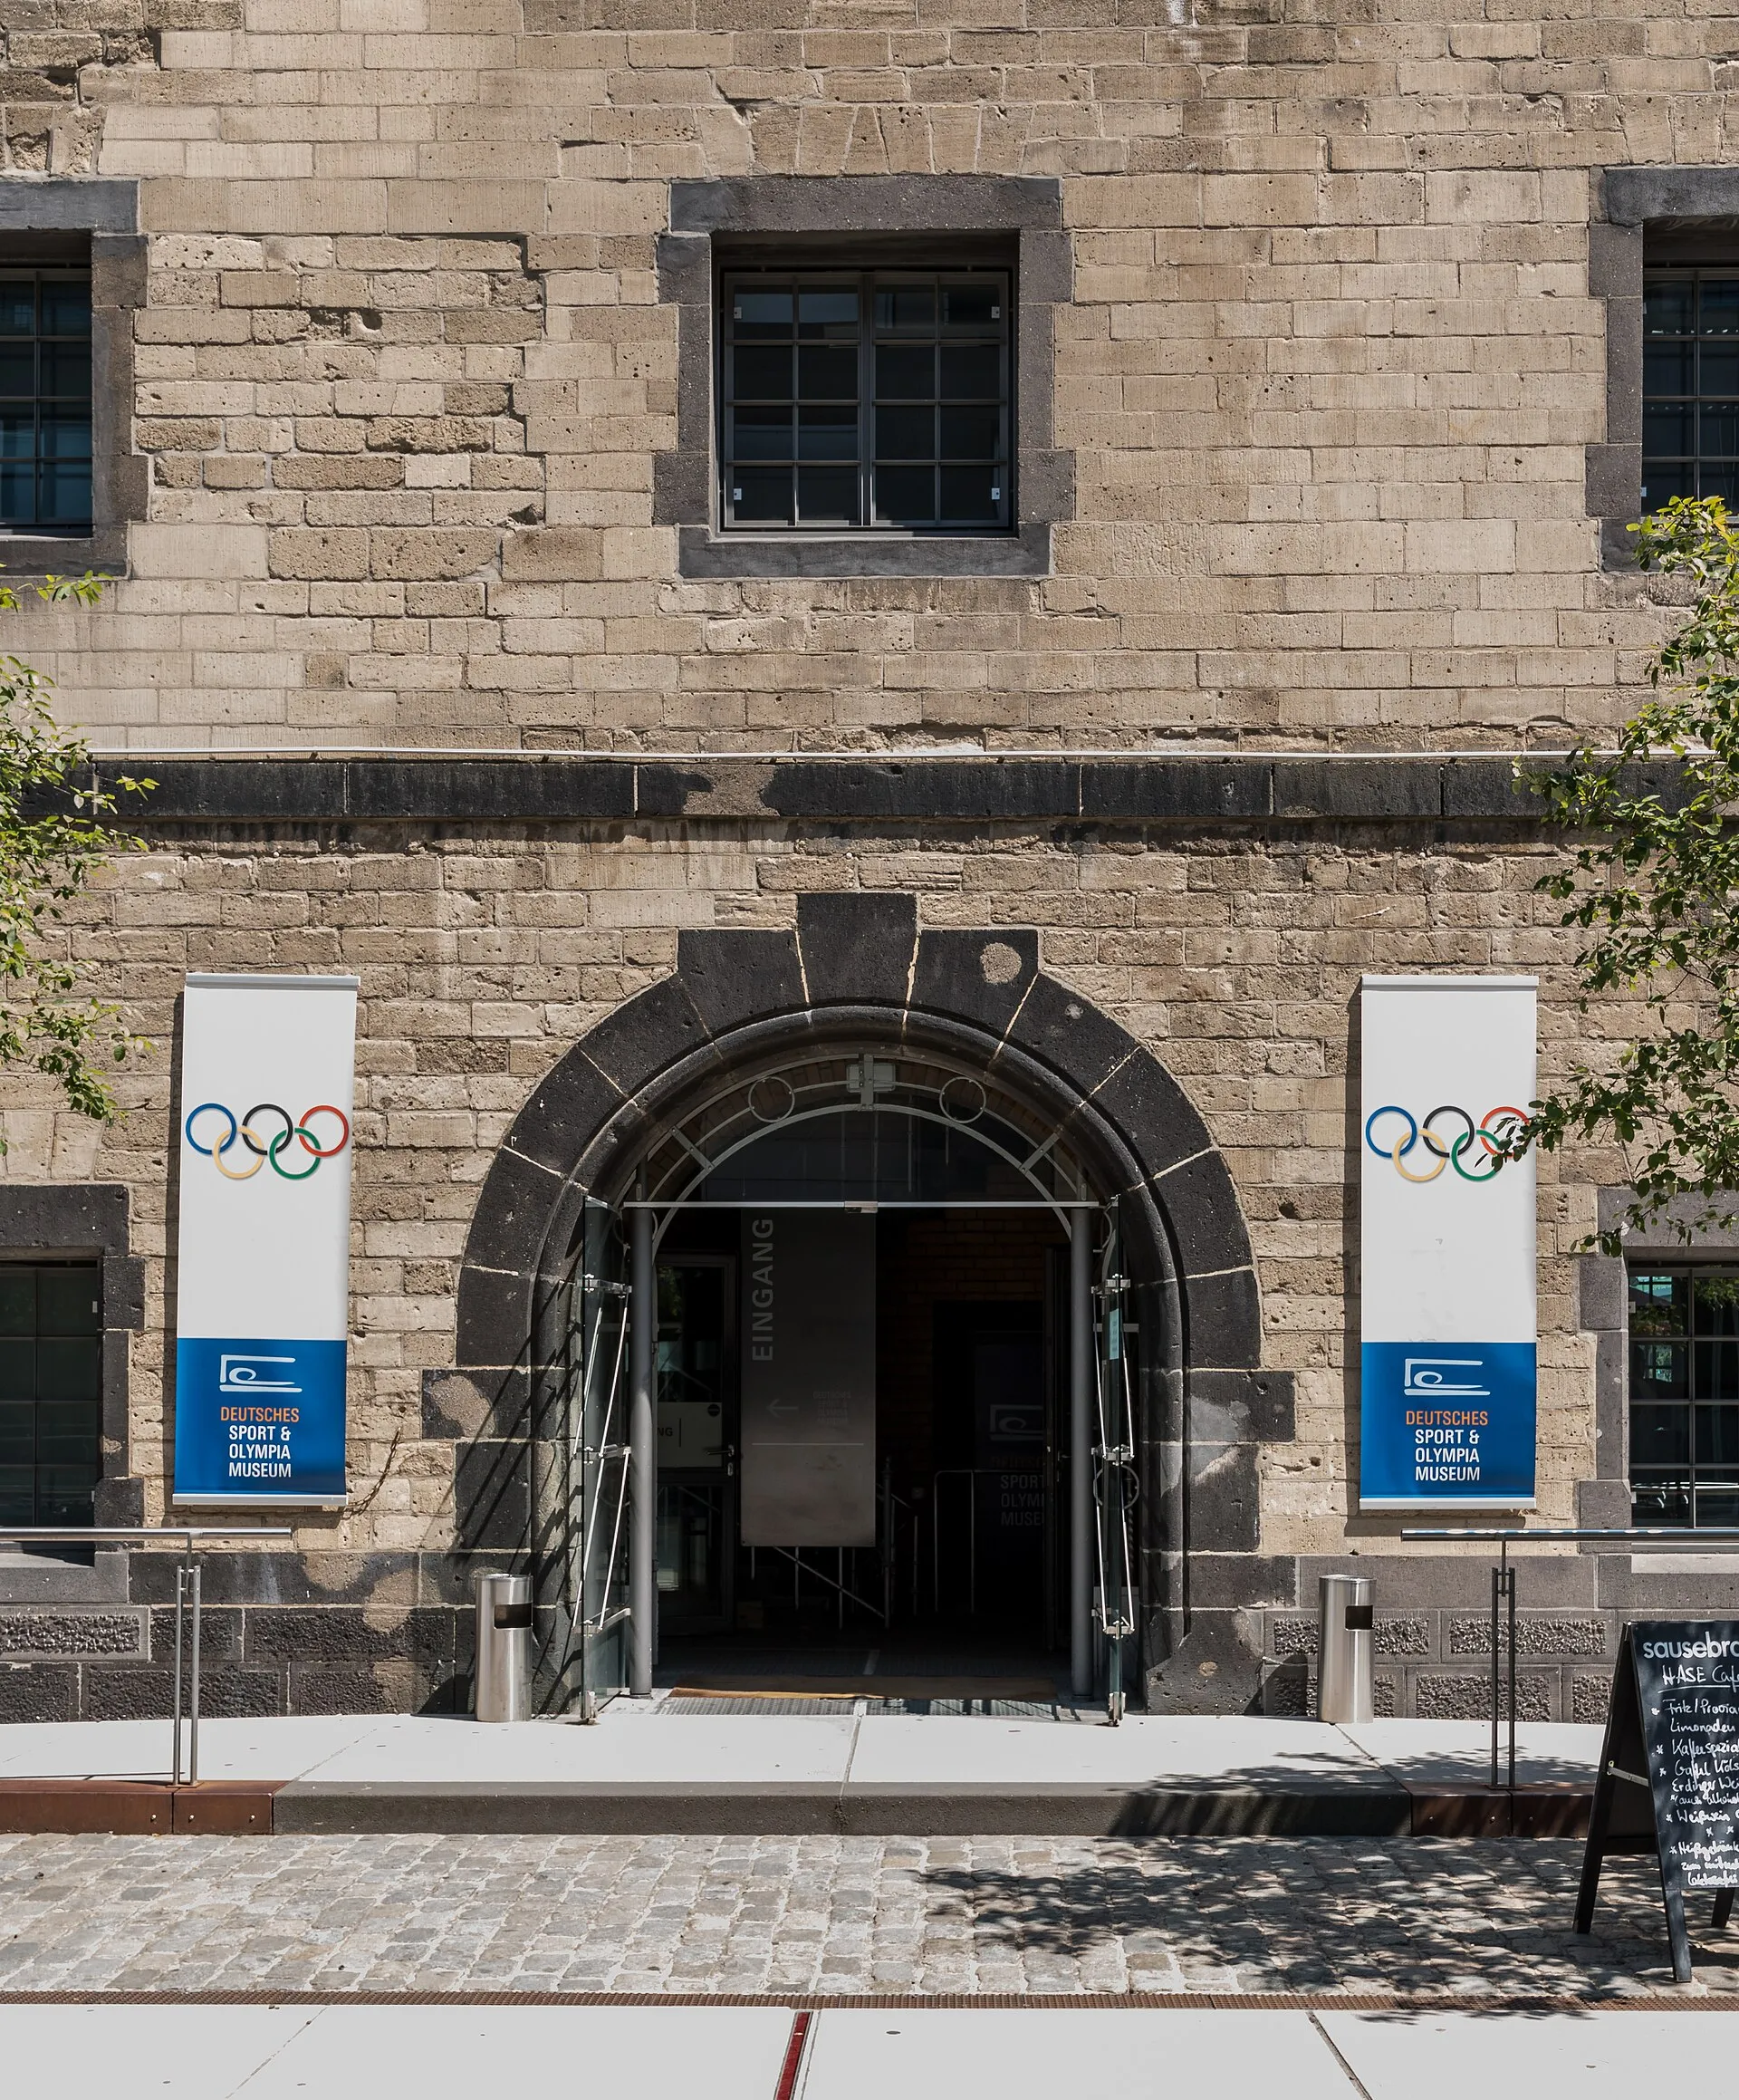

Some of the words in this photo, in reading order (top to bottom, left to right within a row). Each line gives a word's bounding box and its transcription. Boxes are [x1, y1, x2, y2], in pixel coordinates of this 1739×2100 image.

[752, 1218, 773, 1361] EINGANG
[220, 1406, 300, 1422] DEUTSCHES
[1406, 1411, 1488, 1426] DEUTSCHES
[229, 1425, 276, 1440] SPORT
[281, 1426, 292, 1441] &
[1415, 1429, 1464, 1444] SPORT
[1469, 1430, 1480, 1445] &
[229, 1444, 291, 1459] OLYMPIA
[1415, 1448, 1480, 1463] OLYMPIA
[229, 1462, 292, 1478] MUSEUM
[1415, 1466, 1480, 1481] MUSEUM
[1001, 1493, 1044, 1508] OLYM
[1001, 1511, 1044, 1526] MUSE
[1662, 1664, 1706, 1686] HASE
[1670, 1717, 1736, 1735] Limonaden
